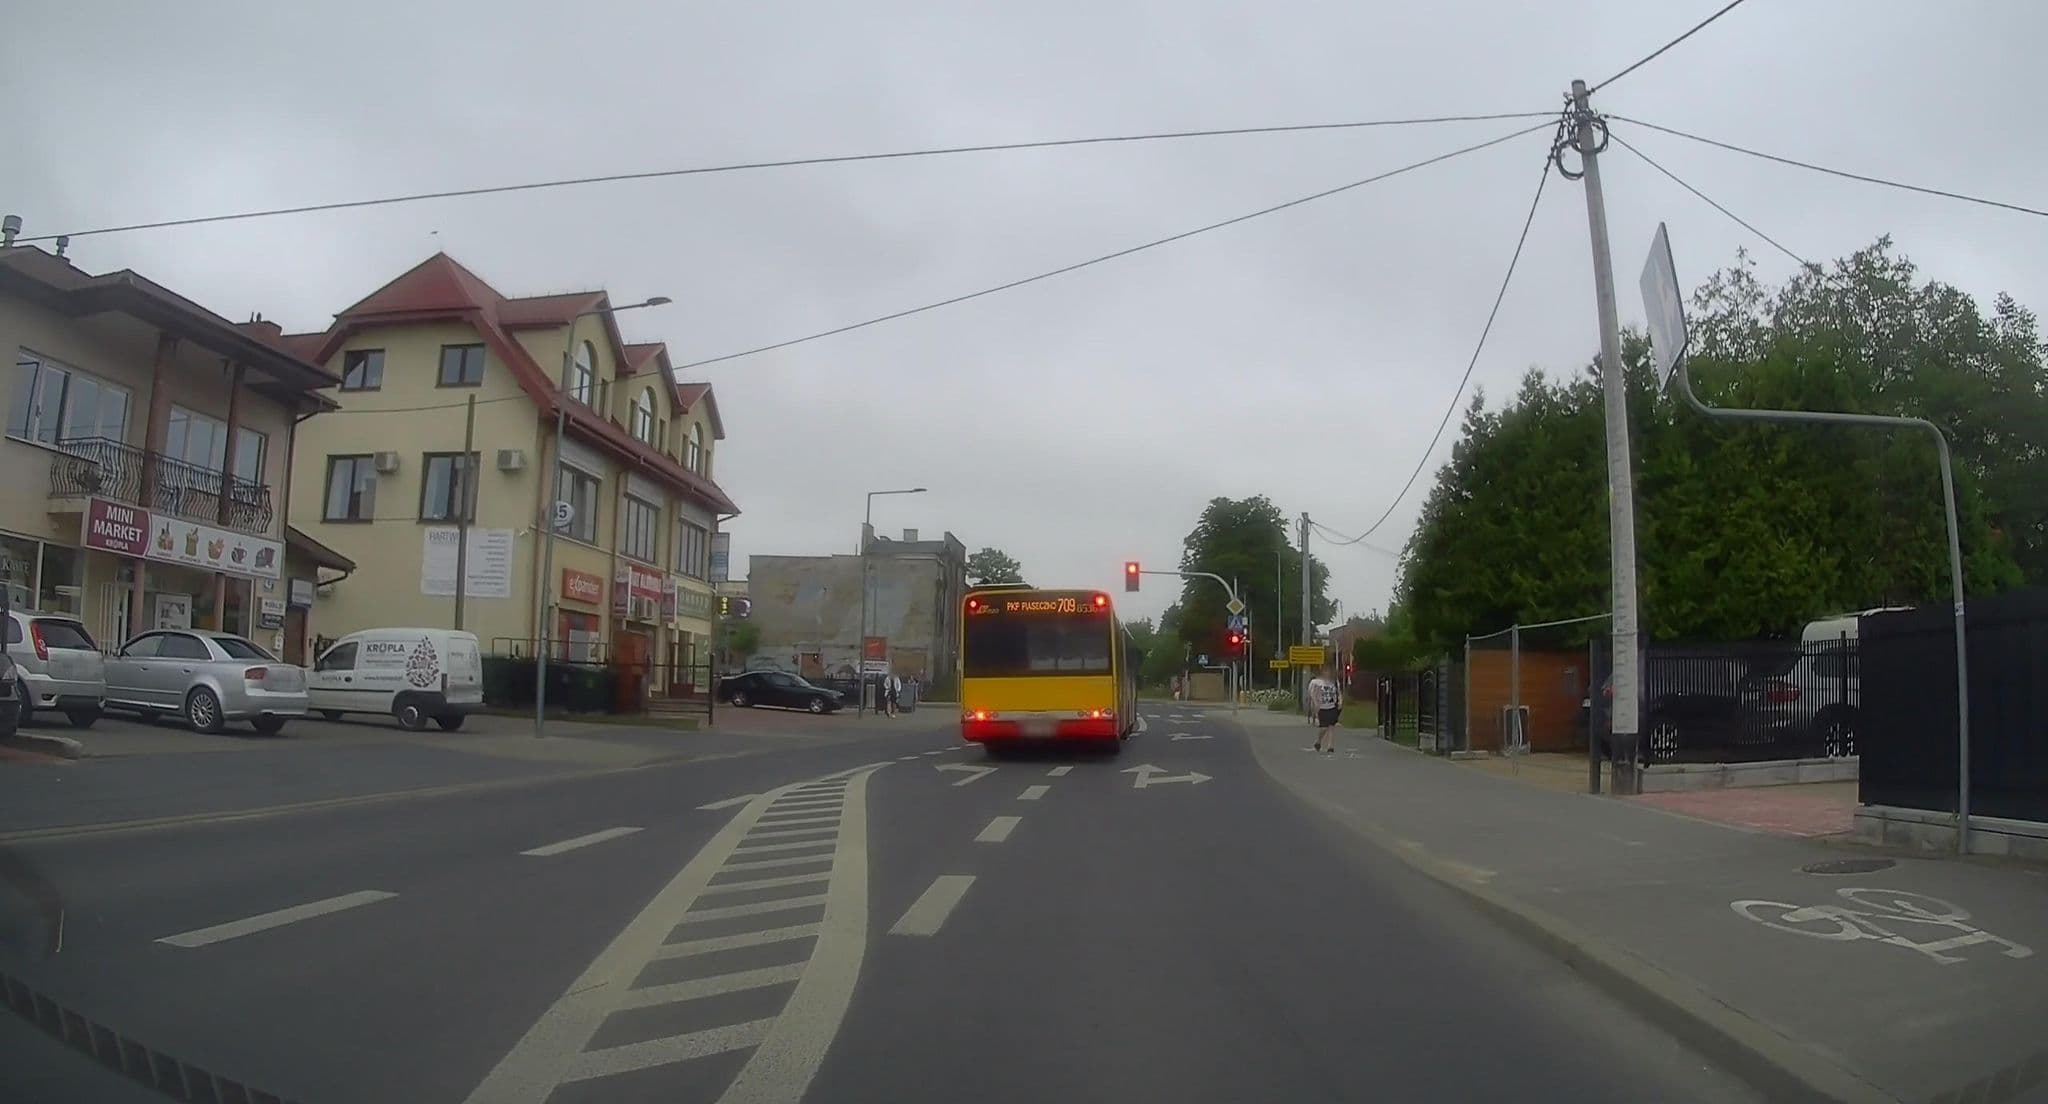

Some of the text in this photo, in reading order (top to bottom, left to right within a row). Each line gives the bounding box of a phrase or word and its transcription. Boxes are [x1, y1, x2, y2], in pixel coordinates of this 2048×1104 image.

[106, 506, 134, 525] MINI
[93, 520, 143, 543] MARKET
[1006, 601, 1020, 611] PKP
[1021, 601, 1057, 611] PIASECZNO
[1057, 598, 1076, 613] 709
